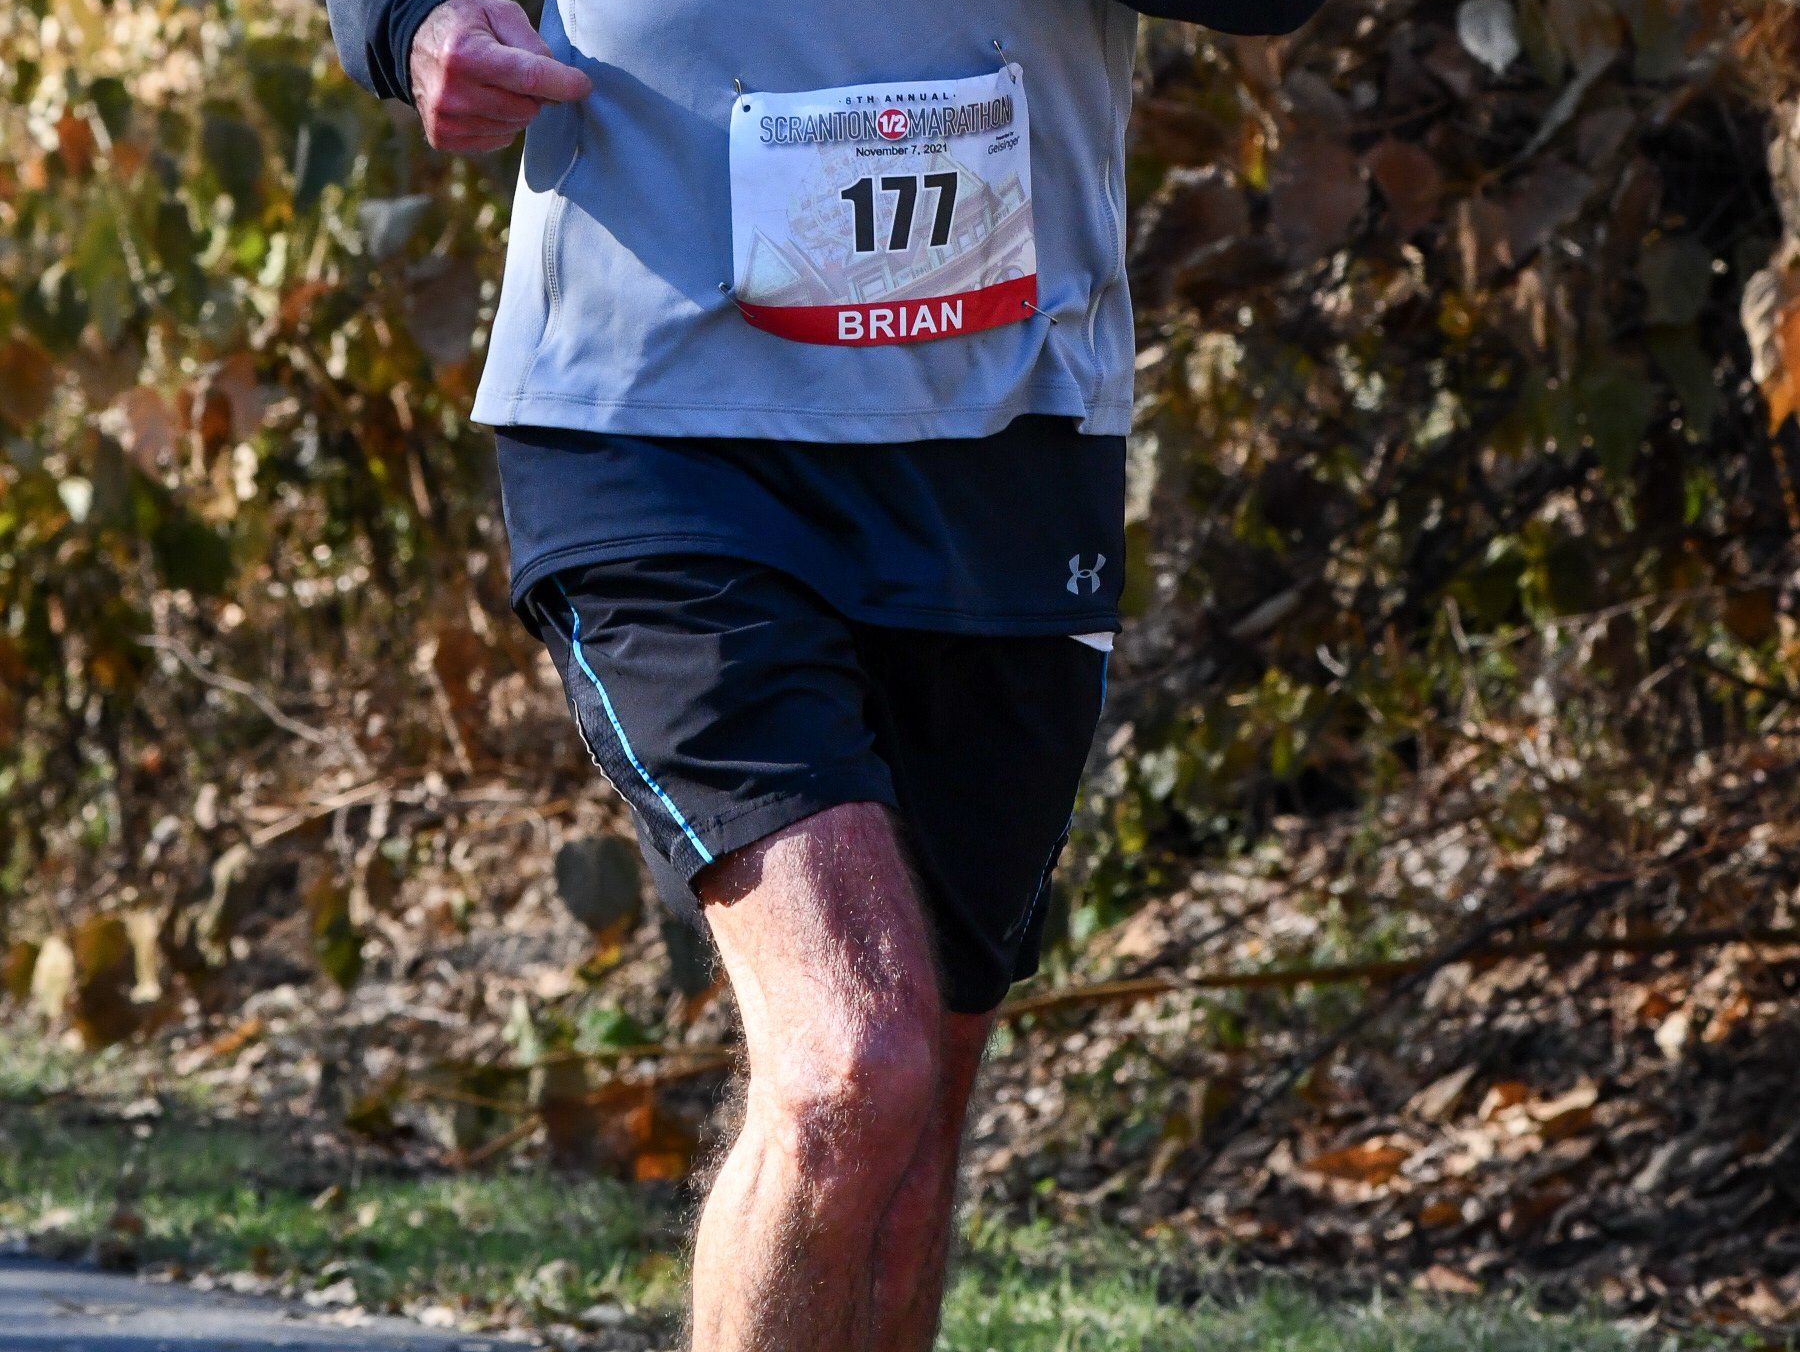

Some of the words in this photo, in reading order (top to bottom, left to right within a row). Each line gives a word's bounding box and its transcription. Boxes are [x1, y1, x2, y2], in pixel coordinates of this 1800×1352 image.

[884, 92, 949, 103] ANNUAL
[759, 109, 878, 144] SCRANTON
[907, 94, 1013, 139] MARATHON
[855, 146, 909, 158] November
[923, 143, 948, 155] 2021
[840, 171, 958, 252] 177
[837, 299, 964, 340] BRIAN
